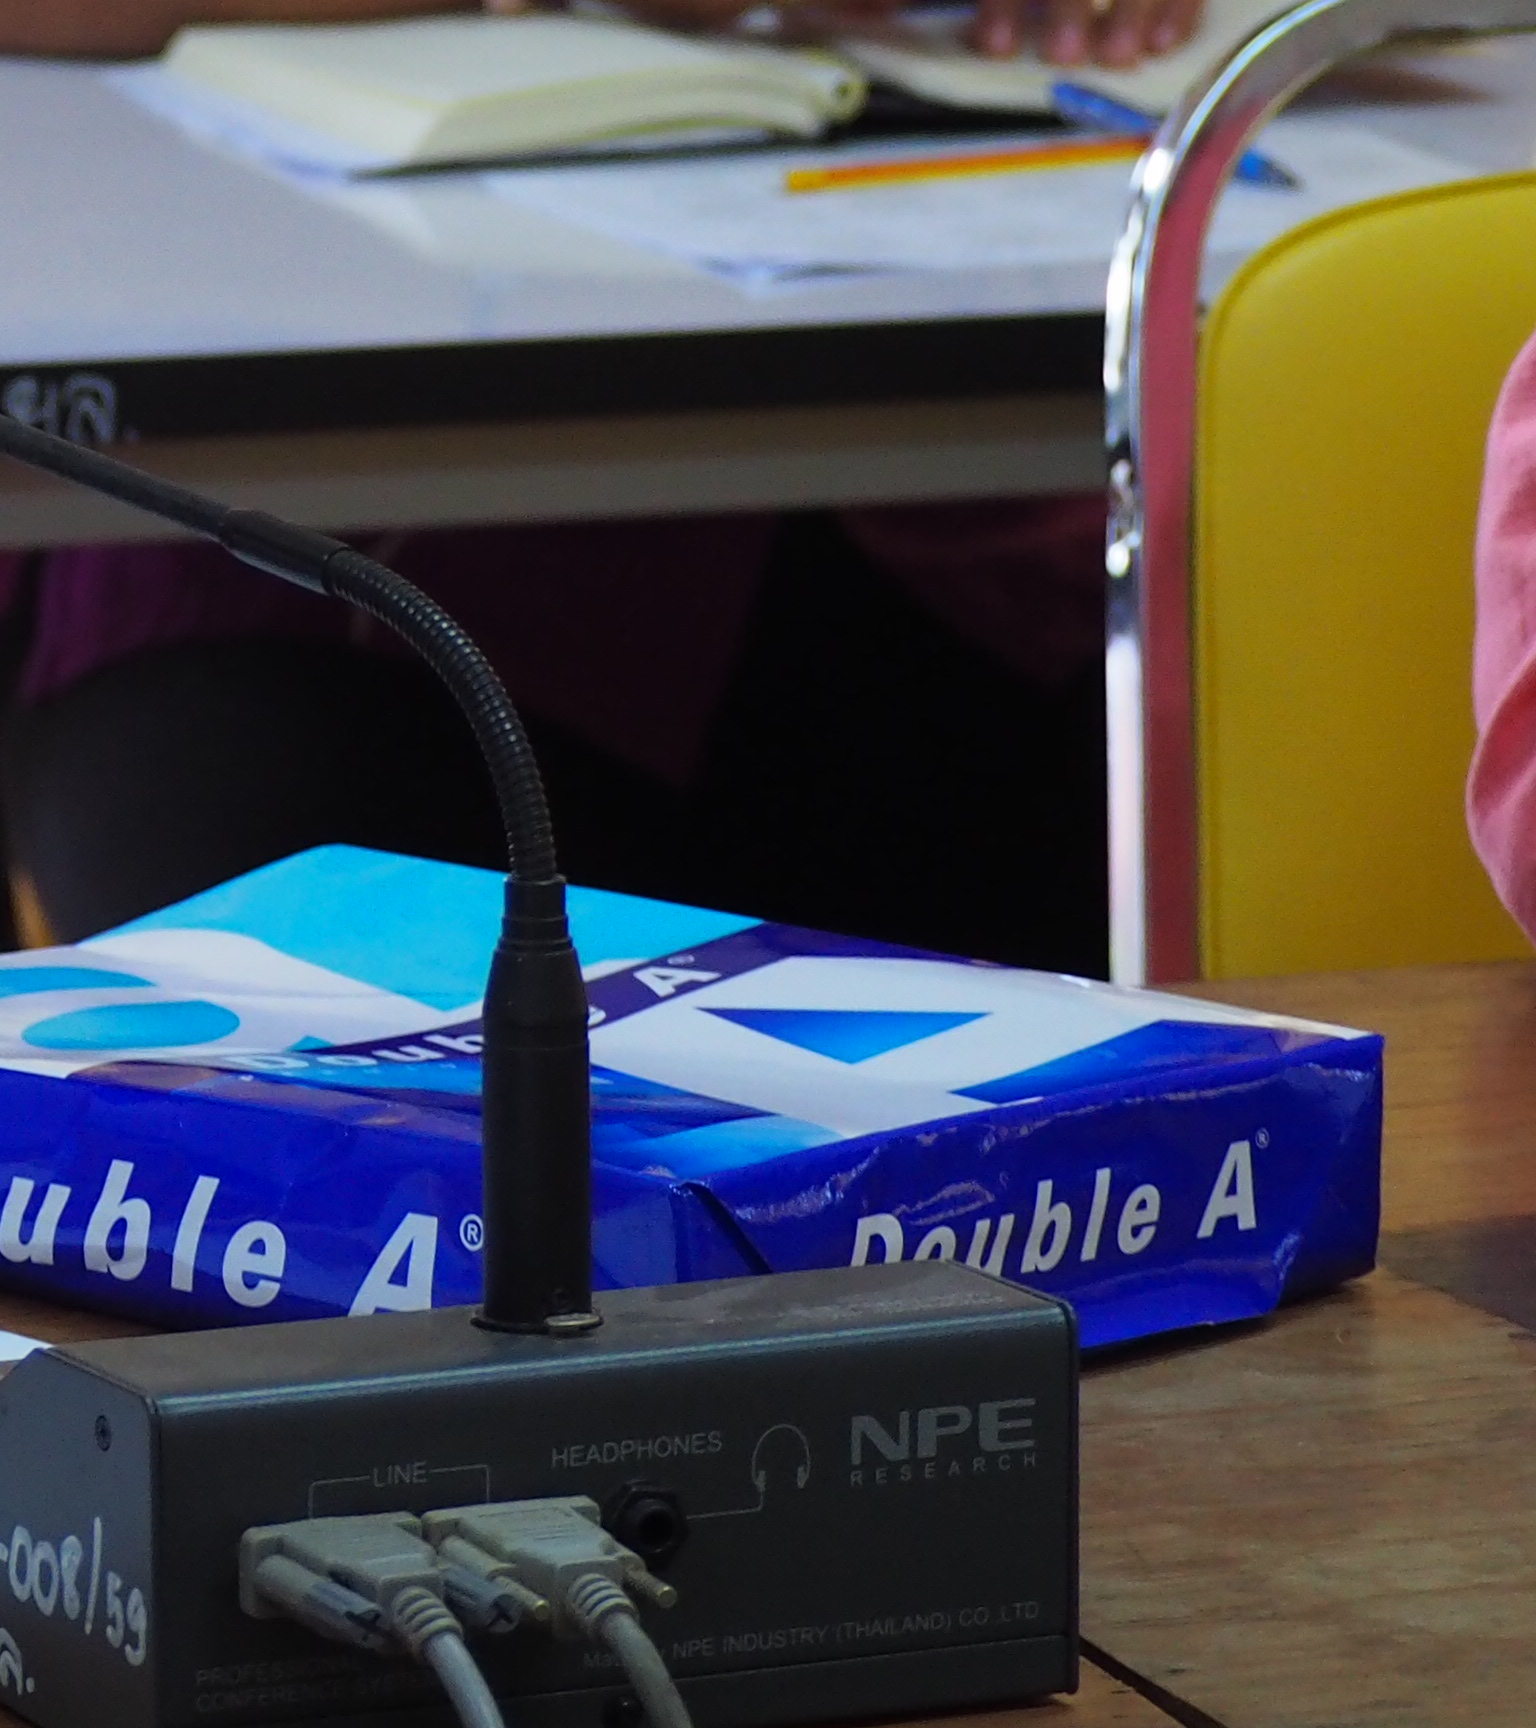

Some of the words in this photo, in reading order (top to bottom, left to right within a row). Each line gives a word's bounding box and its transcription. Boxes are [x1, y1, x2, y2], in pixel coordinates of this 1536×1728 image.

[551, 1431, 723, 1469] HEADPHONES
[850, 1397, 1037, 1466] NPE
[372, 1459, 428, 1488] LINE
[850, 1454, 1037, 1486] RESEARCH
[672, 1638, 716, 1659] NPE
[722, 1624, 828, 1654] INDUSTRY
[835, 1611, 952, 1644] (THAILAND)
